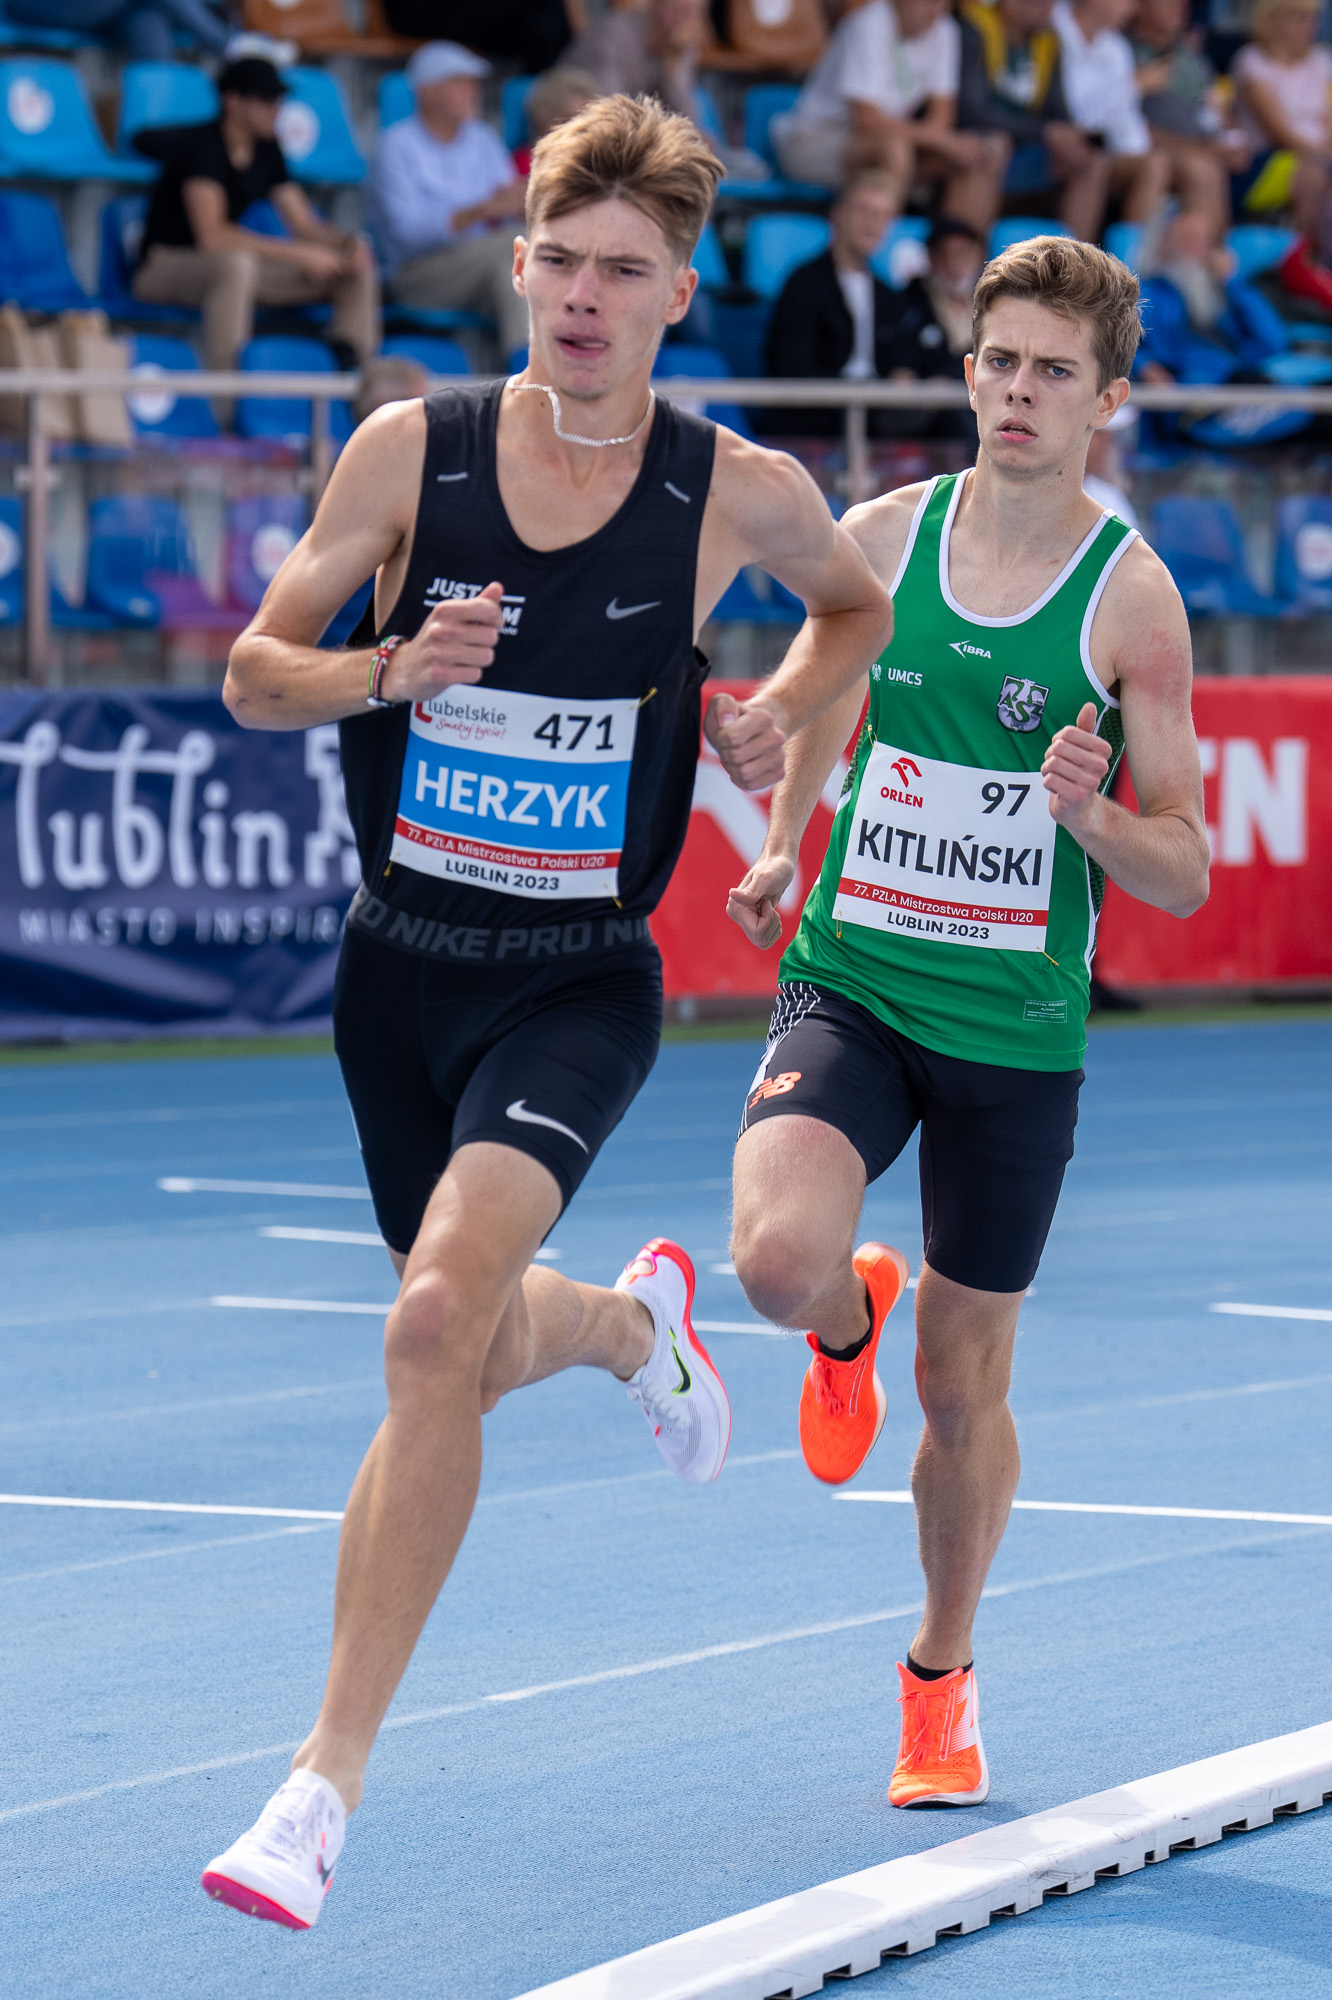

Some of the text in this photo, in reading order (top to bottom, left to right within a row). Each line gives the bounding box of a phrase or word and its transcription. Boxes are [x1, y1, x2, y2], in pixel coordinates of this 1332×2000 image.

[426, 577, 483, 600] JUST
[887, 667, 923, 686] UMCS
[428, 699, 506, 726] lubelskie
[533, 713, 614, 751] 471
[415, 759, 610, 829] HERZYK
[880, 786, 924, 808] ORLEN
[981, 782, 1031, 816] 97
[407, 826, 606, 869] 77. PZLA Mistrzostwa Polski U20
[857, 818, 1044, 887] KITLIŃSKI
[445, 859, 560, 891] LUBLIN 2023
[853, 883, 1034, 923] 77. PZLA Mistrzostwa Polski U20
[19, 905, 341, 945] MIASTO INSPIR
[386, 911, 491, 959] NIKE
[496, 921, 592, 960] PRO
[887, 911, 990, 940] LUBLIN 2023
